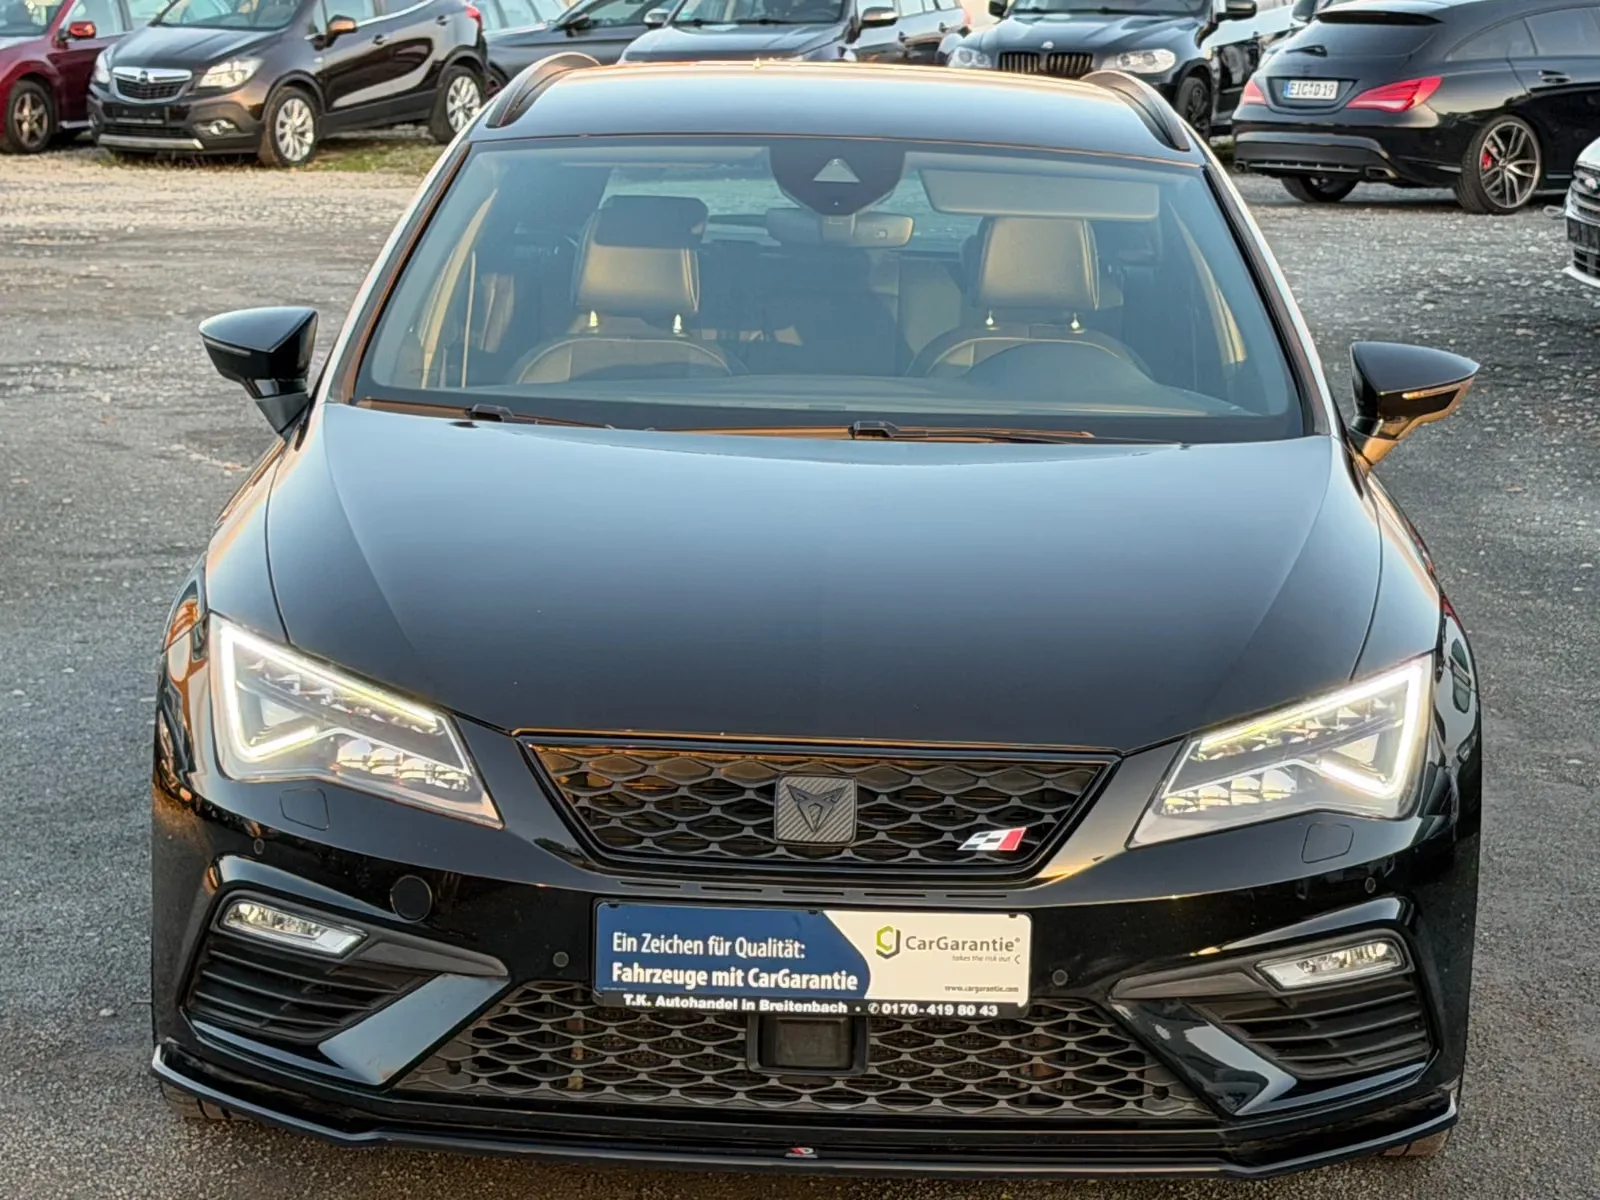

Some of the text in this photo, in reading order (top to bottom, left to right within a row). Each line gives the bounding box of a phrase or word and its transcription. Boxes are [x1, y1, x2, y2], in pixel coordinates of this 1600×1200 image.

[612, 931, 805, 959] Ein Zeichen für Qualität:
[612, 962, 858, 991] Fahrzeuge mit CarGarantie
[624, 993, 652, 1006] T.K.
[656, 995, 738, 1010] Autohandel
[742, 999, 755, 1010] in
[759, 1001, 848, 1014] Breitenbach
[957, 1004, 976, 1016] 80
[979, 1004, 998, 1016] 43
